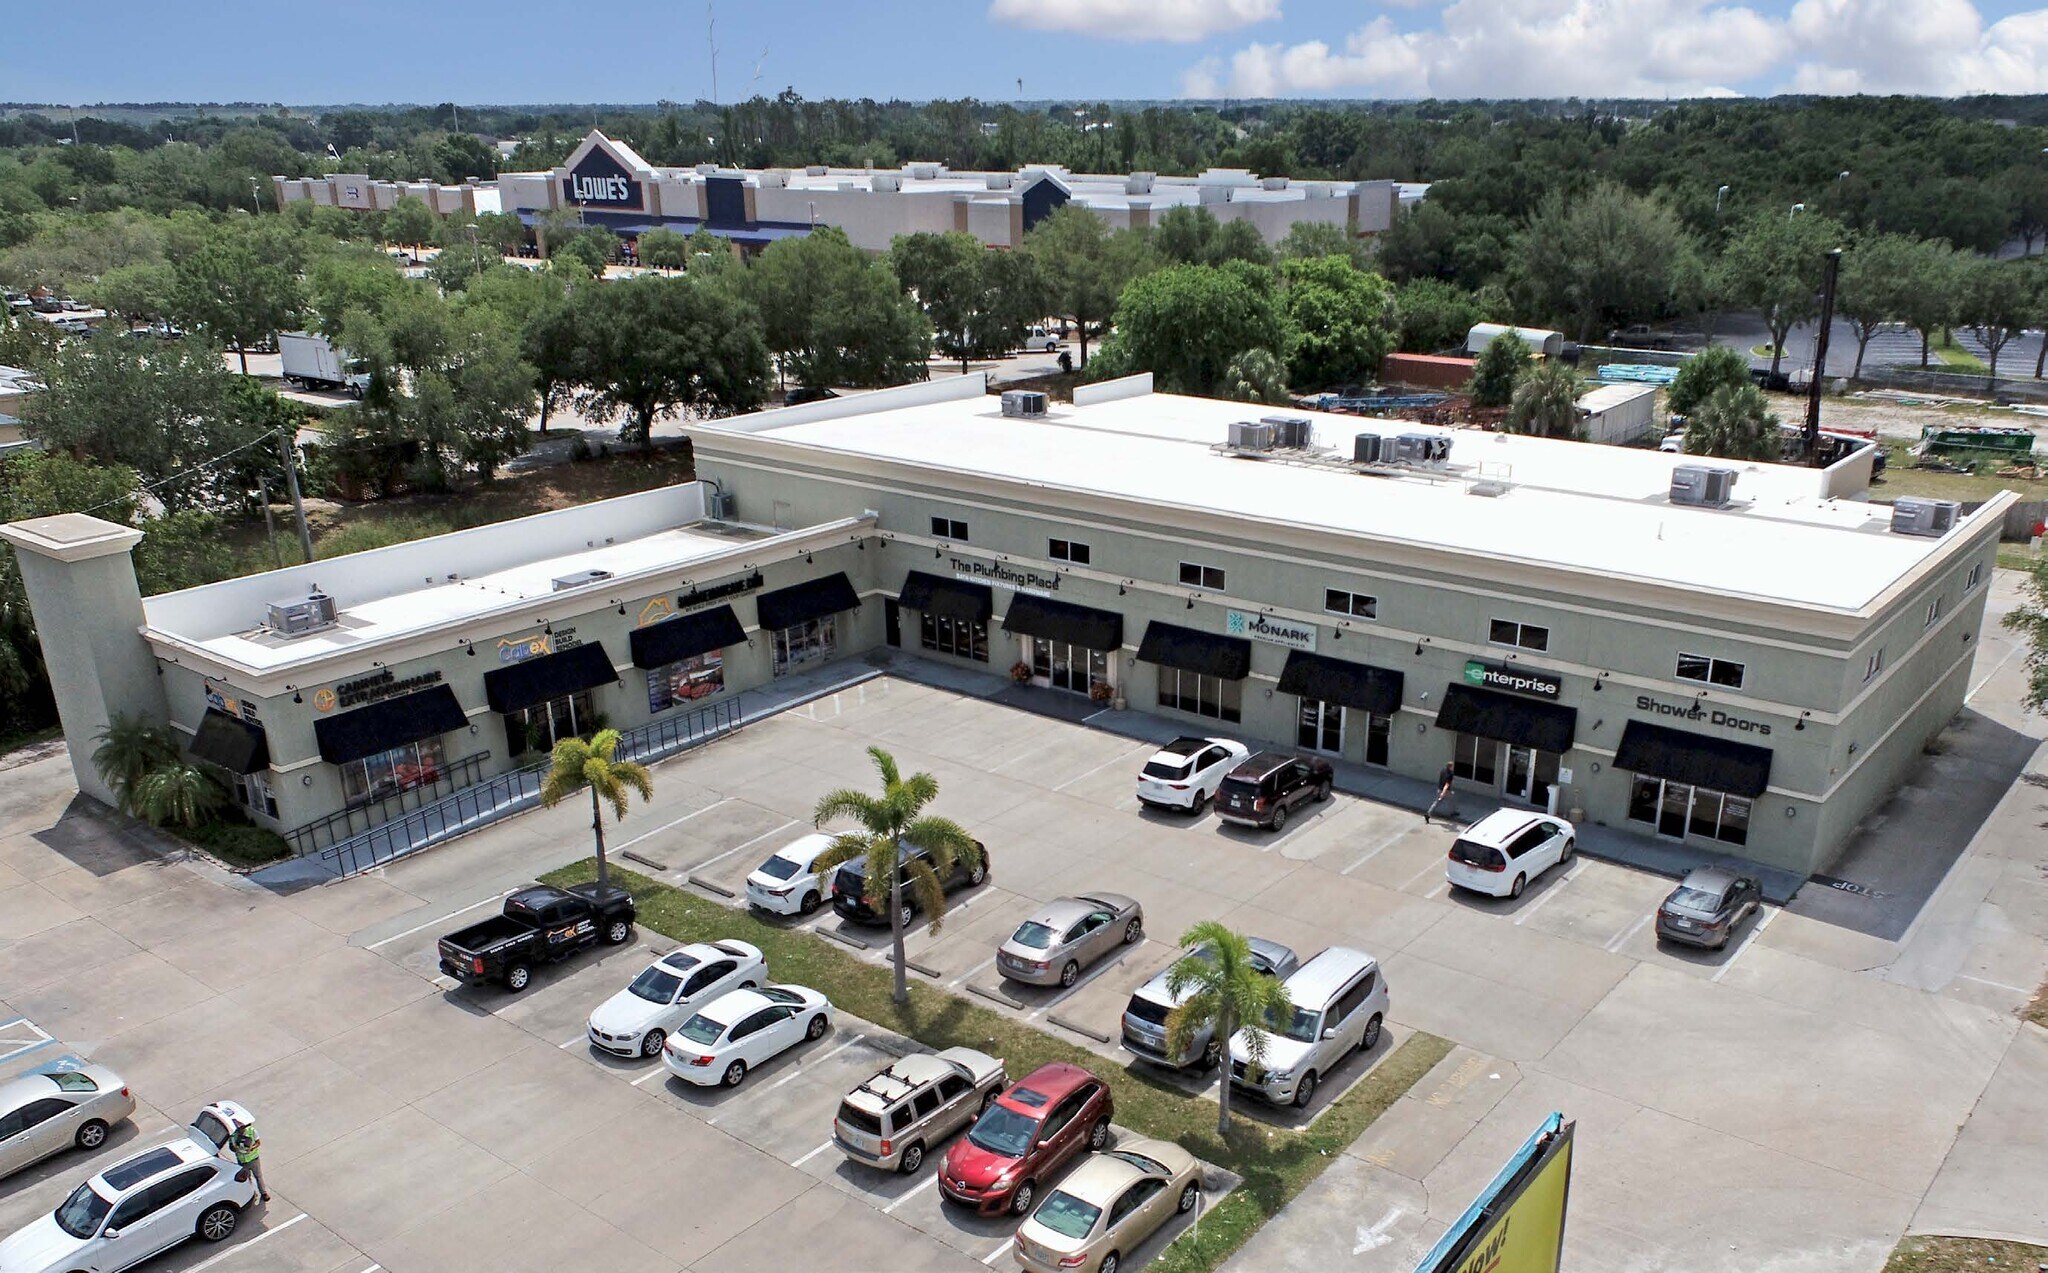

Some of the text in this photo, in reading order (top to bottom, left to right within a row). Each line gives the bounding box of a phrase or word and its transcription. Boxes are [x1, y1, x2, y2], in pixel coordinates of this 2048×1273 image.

[572, 173, 629, 200] LOWE'S
[950, 558, 1060, 591] The Plumbing Place
[1249, 621, 1309, 642] MONARK
[1467, 668, 1556, 694] enterprise
[1636, 696, 1772, 735] Shower Doors
[1832, 881, 1883, 899] STOP
